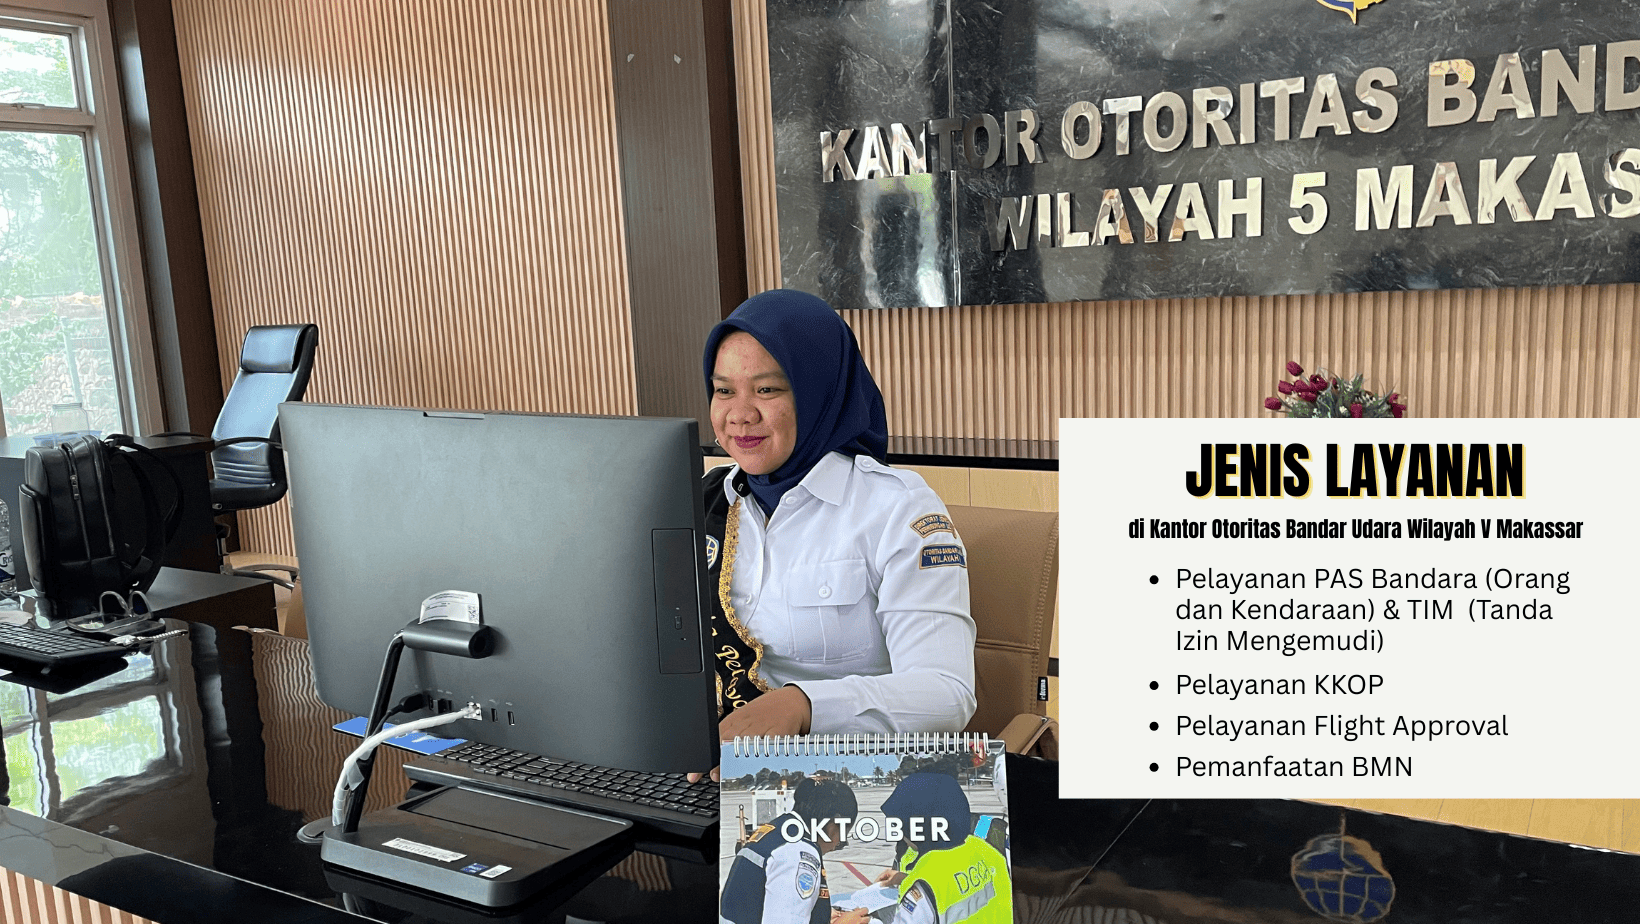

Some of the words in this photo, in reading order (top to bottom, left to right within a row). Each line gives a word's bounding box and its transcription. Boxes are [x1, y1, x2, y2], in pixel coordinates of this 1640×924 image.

[819, 109, 1044, 183] KANTOR
[1061, 67, 1399, 160] OTORITAS
[984, 177, 1263, 252] WILAYAH
[1288, 172, 1328, 235] 5
[1355, 148, 1640, 231] MAKAS
[931, 554, 960, 564] WILAYAH
[781, 817, 950, 843] OKTOBER
